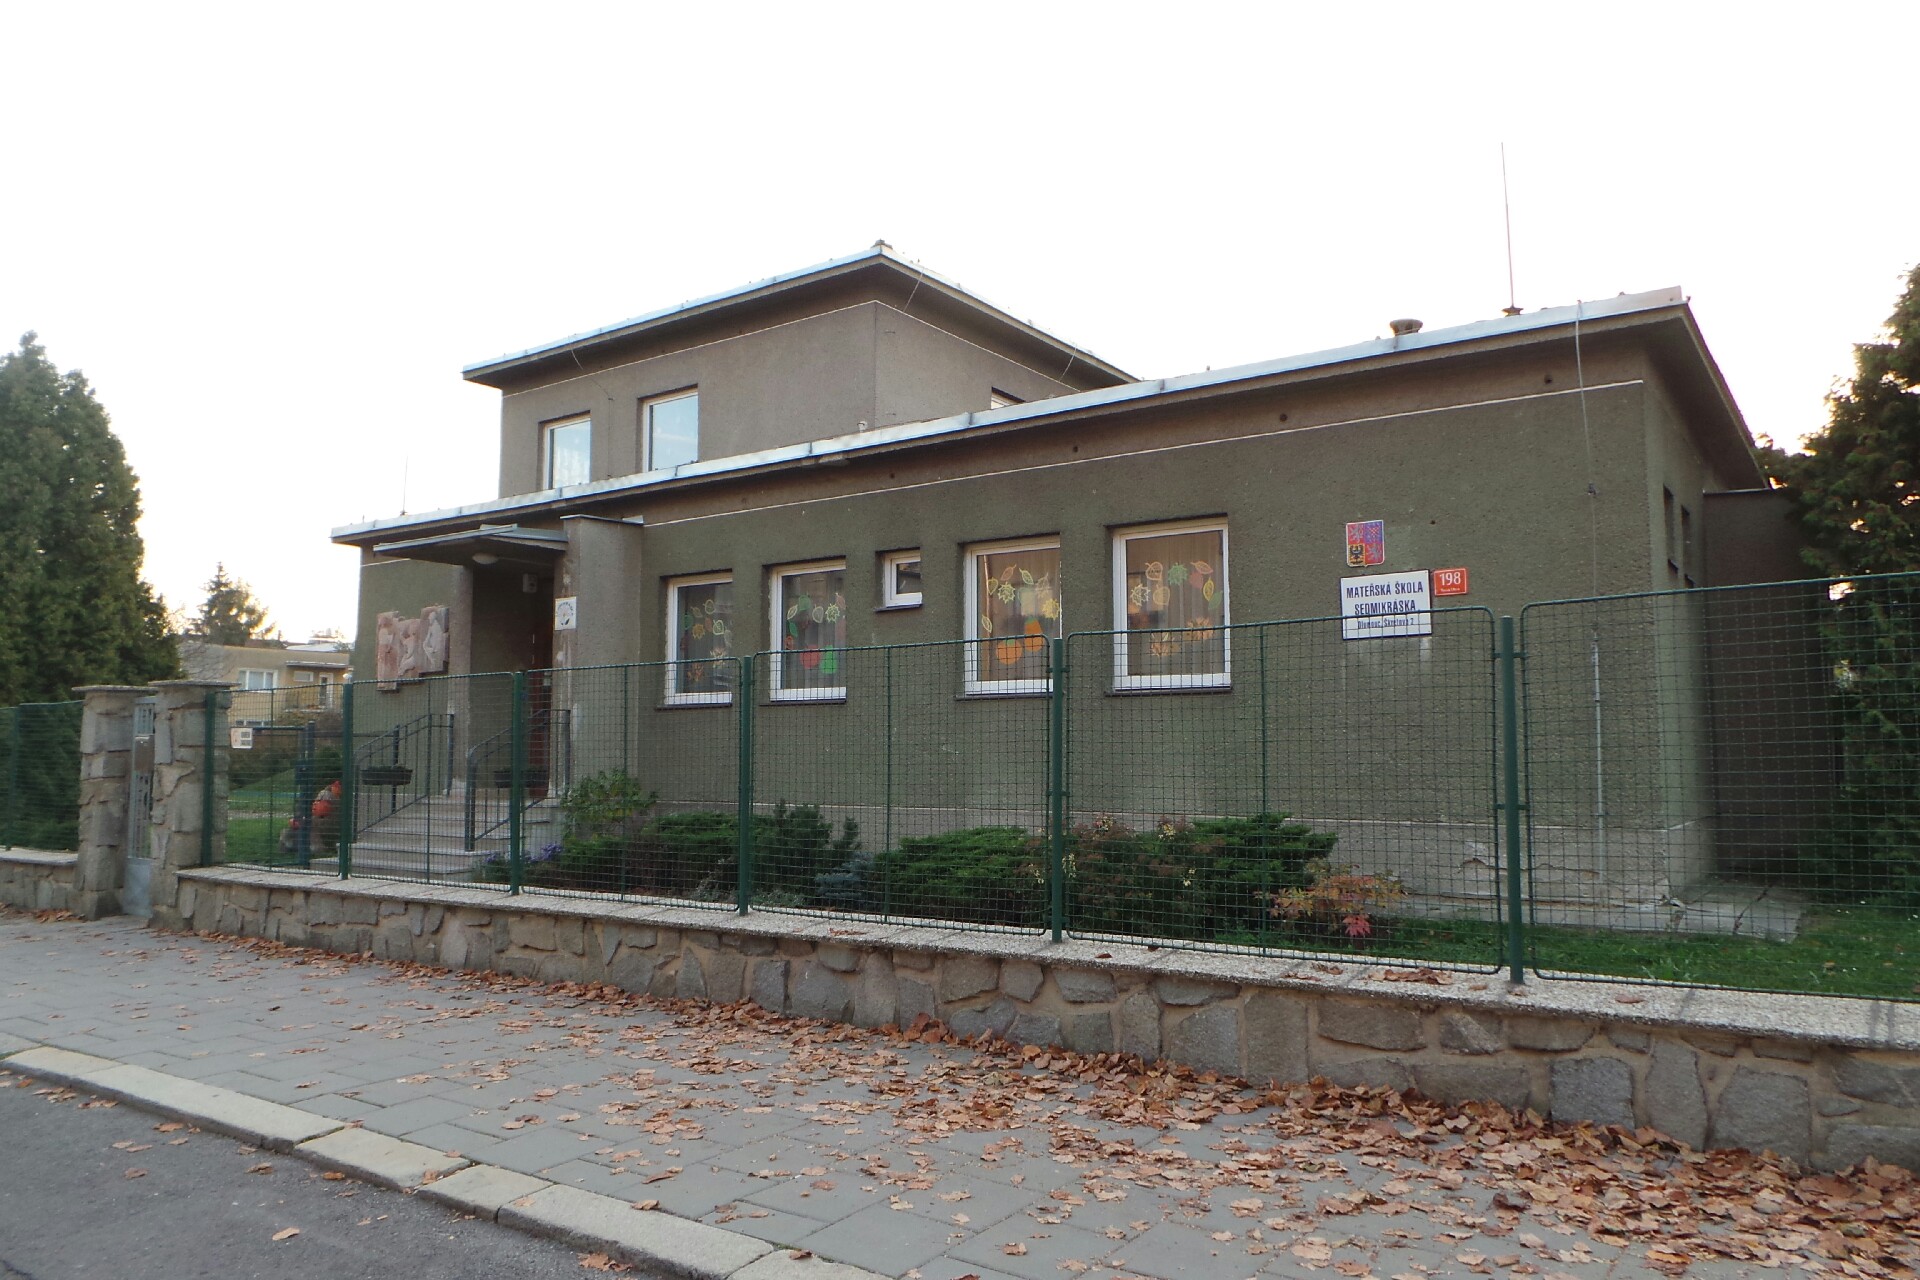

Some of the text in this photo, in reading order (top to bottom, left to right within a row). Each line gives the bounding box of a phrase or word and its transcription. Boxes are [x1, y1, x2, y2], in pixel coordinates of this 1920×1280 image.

[1440, 571, 1461, 586] 198
[1346, 581, 1424, 599] MATEŘSKÁ ŠKOLA
[1355, 599, 1416, 616] SEDMIKRÁSKA
